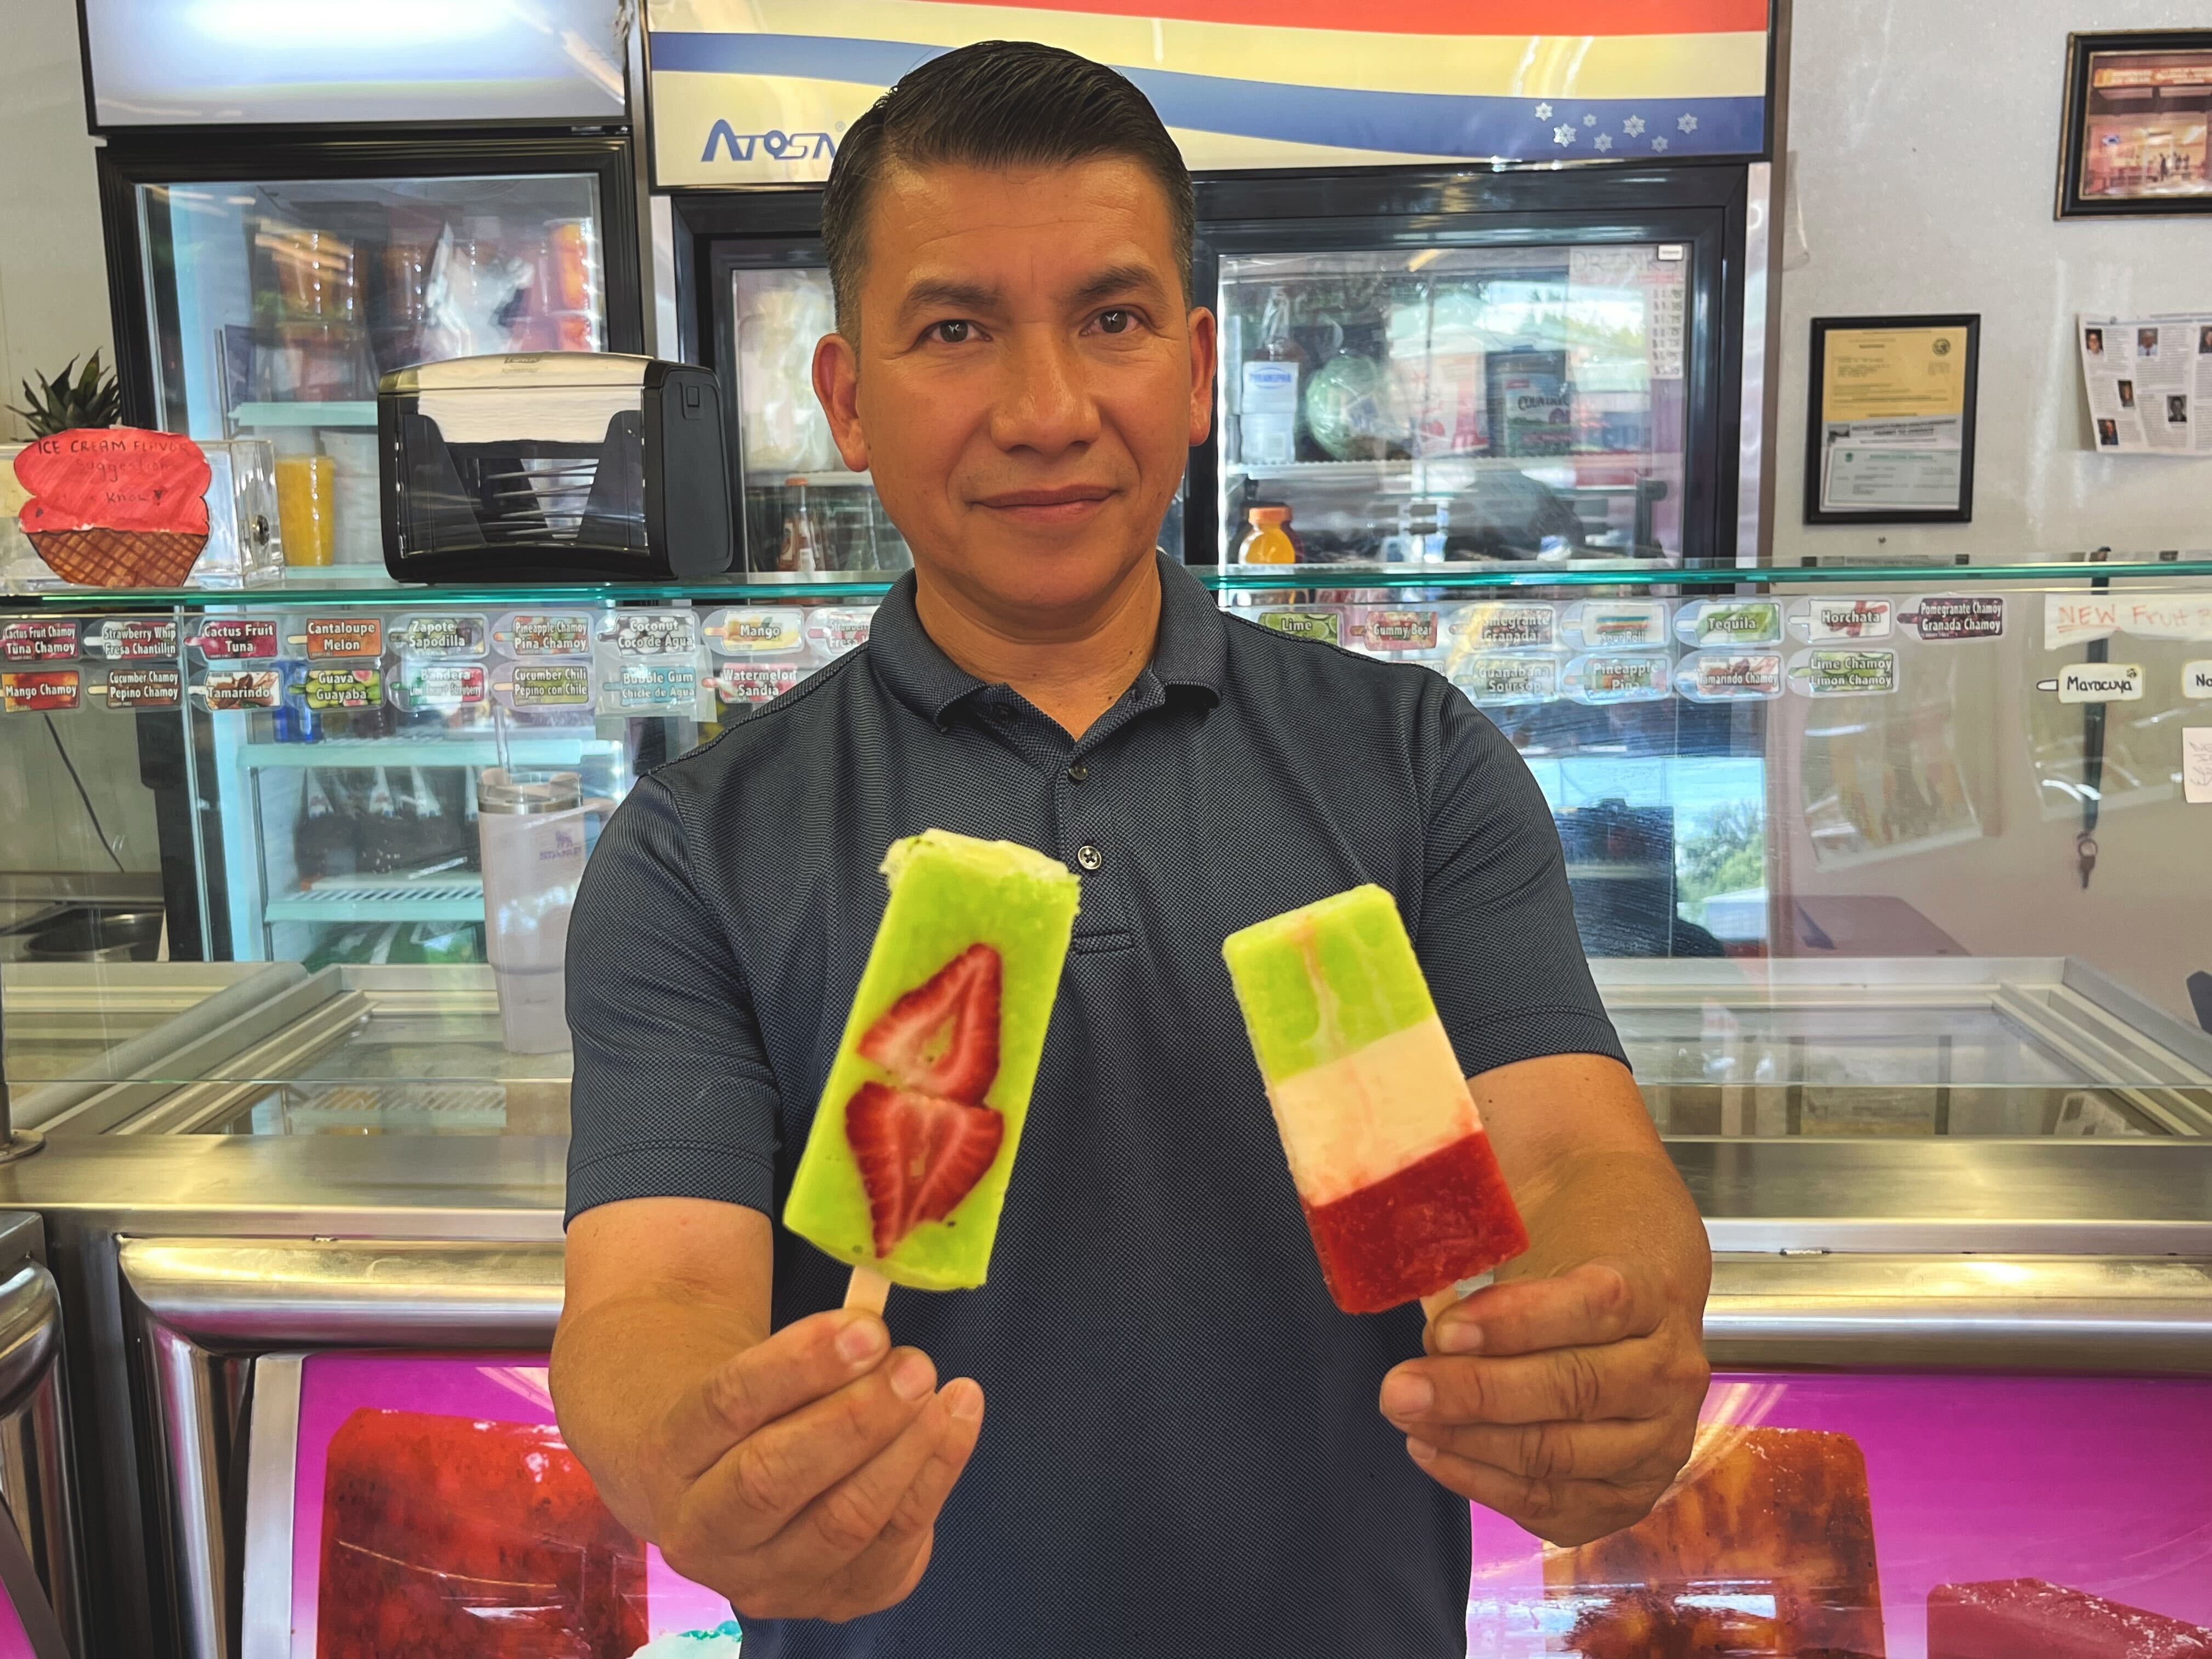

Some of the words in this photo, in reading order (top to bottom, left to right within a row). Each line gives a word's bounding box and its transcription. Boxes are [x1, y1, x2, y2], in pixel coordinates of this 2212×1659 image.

[39, 441, 60, 454] ICE
[71, 440, 126, 453] CREAM
[1921, 603, 1971, 618] Pomegranate
[1972, 602, 2002, 616] Chamoy
[2059, 605, 2115, 625] NEW
[2132, 605, 2188, 626] Fruit
[1821, 611, 1881, 624] Horchata
[5, 627, 27, 639] Cactus
[29, 626, 46, 638] Fruit
[48, 625, 76, 639] Chamoy
[204, 626, 241, 637] Cactus
[246, 624, 273, 636] Fruit
[308, 622, 375, 637] Cantaloupe
[412, 621, 455, 635] Zapote
[515, 622, 555, 636] Pineapple
[557, 621, 587, 635] Chamoy
[630, 620, 679, 631] Coconut
[740, 624, 781, 639] Mango
[1282, 618, 1312, 632] Lime
[1374, 623, 1409, 639] Gummy
[1412, 623, 1431, 635] Bear
[1708, 617, 1756, 633] Tequila
[1922, 618, 1961, 631] Granada
[1964, 618, 2001, 633] Chamoy
[104, 628, 152, 642] Strawberry
[154, 627, 176, 641] Whip
[409, 635, 465, 648] Sapodilla
[1483, 630, 1536, 642] Granada
[7, 643, 31, 654] Tuna
[35, 641, 75, 656] Chamoy
[225, 641, 254, 652] Tuna
[543, 638, 586, 651] Chamoy
[618, 637, 646, 648] Coco
[648, 637, 661, 646] de
[665, 635, 693, 650] Agua
[105, 644, 130, 656] Fresa
[1593, 661, 1659, 676] Pineapple
[1811, 657, 1840, 669] Lime
[1844, 657, 1892, 672] Chamoy
[110, 672, 146, 684] Cucumber
[149, 671, 178, 685] Chamoy
[318, 673, 354, 684] Guava
[421, 669, 471, 680] Bandera
[515, 669, 562, 680] Cucumber
[565, 668, 586, 679] Chili
[623, 671, 664, 684] Bubble
[668, 671, 694, 682] Gum
[723, 668, 797, 681] Watermelon
[1699, 673, 1743, 685] Tamarindo
[1745, 672, 1778, 686] Chamoy
[1849, 674, 1892, 687] Chamoy
[6, 686, 37, 699] Mango
[40, 684, 76, 697] Chamoy
[208, 686, 270, 698] Tamarindo
[515, 685, 545, 698] Pepino
[548, 686, 562, 695] con
[565, 683, 588, 695] Chile
[1488, 680, 1542, 693] Soursop
[2067, 676, 2132, 694] Maracuya
[110, 687, 141, 701] Pepino
[144, 686, 178, 700] Chamoy
[316, 689, 367, 703] Guayaba
[622, 689, 652, 698] Chicle
[654, 688, 667, 697] de
[670, 687, 695, 698] Agua
